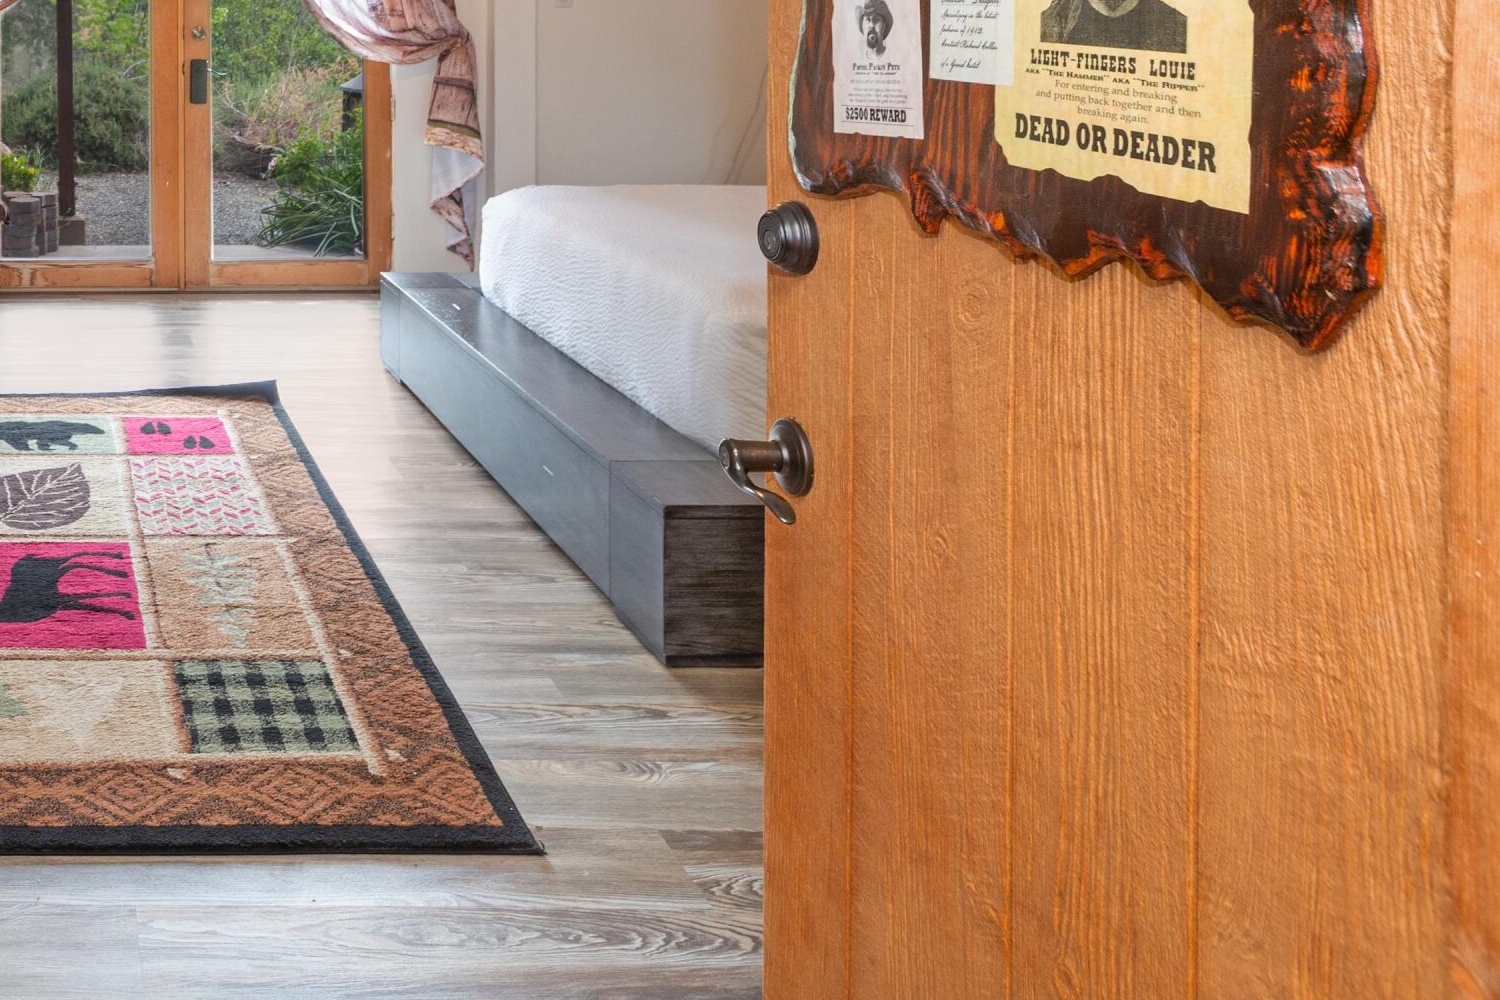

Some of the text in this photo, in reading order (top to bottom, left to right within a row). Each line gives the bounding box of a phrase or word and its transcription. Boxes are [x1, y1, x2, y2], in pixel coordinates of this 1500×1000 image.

[1025, 67, 1040, 75] AKA
[1112, 77, 1130, 85] AKA
[1149, 59, 1196, 80] LOUIE
[1054, 79, 1178, 104] For entering and breaking
[1035, 89, 1201, 118] and putting back together and then
[845, 107, 907, 123] $2500 REWARD
[1077, 105, 1150, 125] breaking again.
[1015, 112, 1217, 174] DEAD OR DEADER
